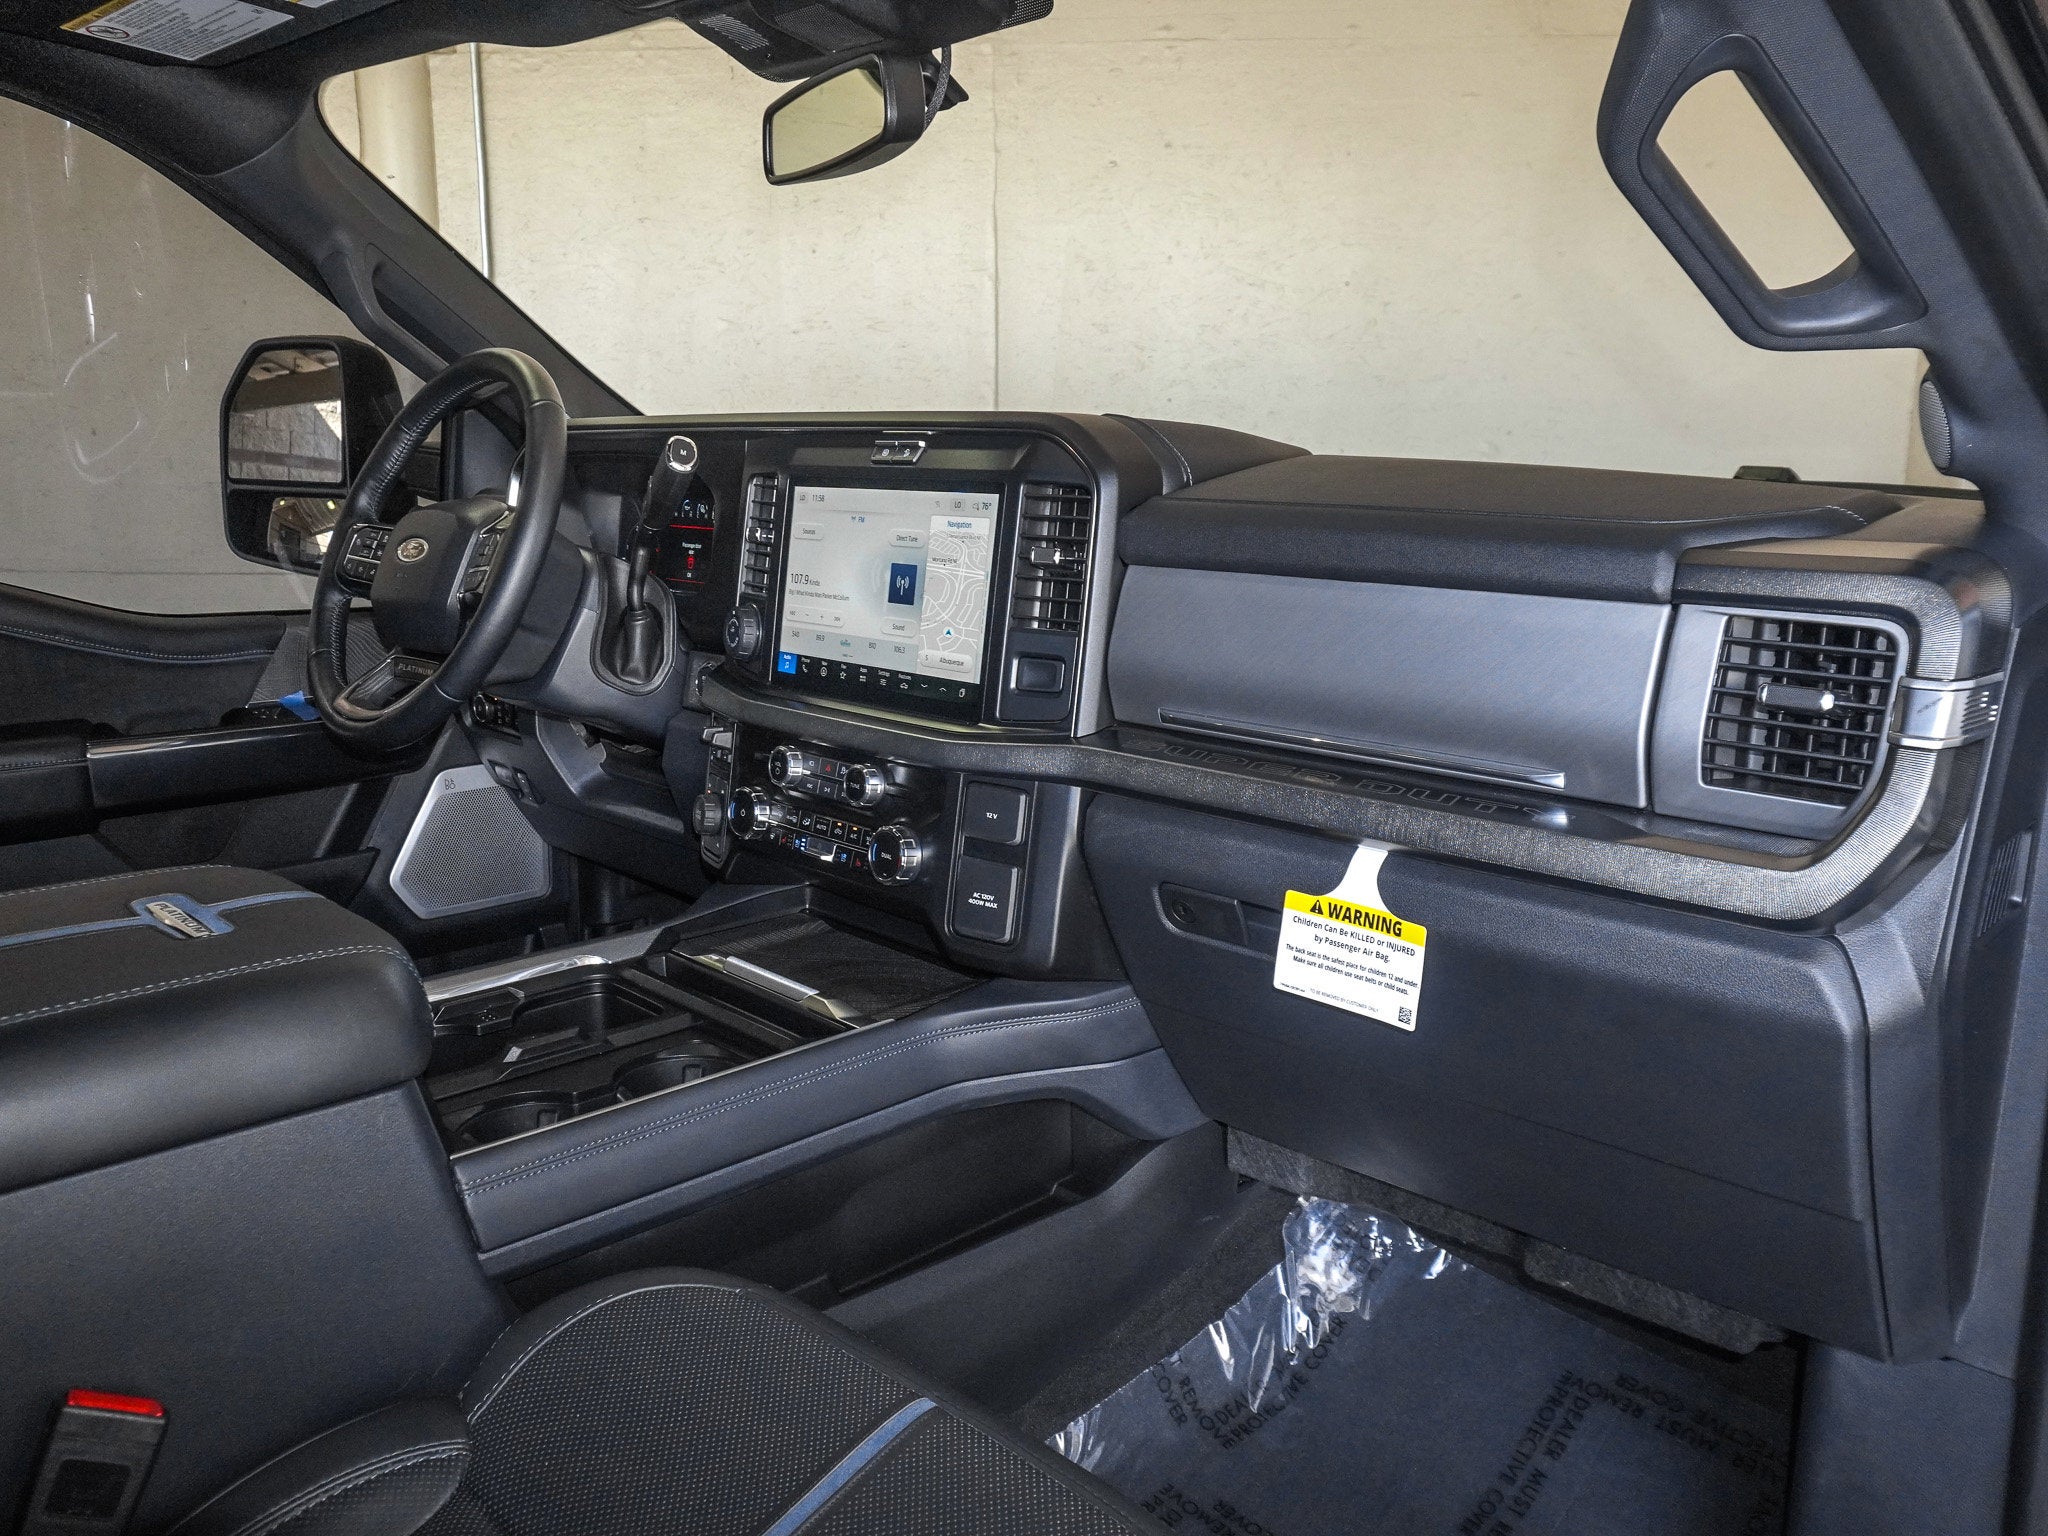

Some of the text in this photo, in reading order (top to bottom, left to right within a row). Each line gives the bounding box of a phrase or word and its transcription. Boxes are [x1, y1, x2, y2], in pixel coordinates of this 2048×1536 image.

[947, 520, 972, 529] Navigation
[790, 573, 810, 585] 107.9
[892, 623, 905, 632] Sound
[398, 662, 434, 676] PLATINUM
[939, 657, 964, 667] Albuquerque
[880, 852, 892, 861] DUAL
[968, 898, 998, 909] 400W MAX
[981, 893, 995, 902] 120V
[154, 903, 208, 934] PLATINUM
[1328, 902, 1402, 937] WARNING
[1293, 915, 1416, 956] Children Can Be KILLED or INJURED
[1314, 934, 1323, 944] by
[1324, 937, 1361, 954] Passenger
[1362, 947, 1373, 956] Air
[1286, 943, 1294, 951] The
[1295, 946, 1306, 954] back
[1331, 957, 1345, 966] safest
[1346, 961, 1358, 970] place
[1367, 967, 1387, 978] children
[1293, 955, 1306, 964] Make
[1324, 965, 1343, 975] children
[1353, 973, 1364, 981] seat
[1364, 976, 1377, 985] belts
[1384, 982, 1396, 991] child
[1395, 986, 1409, 995] seats.
[1321, 991, 1340, 1001] REMOVED
[1304, 1316, 1348, 1370] COVER
[1508, 1467, 1548, 1518] MUST
